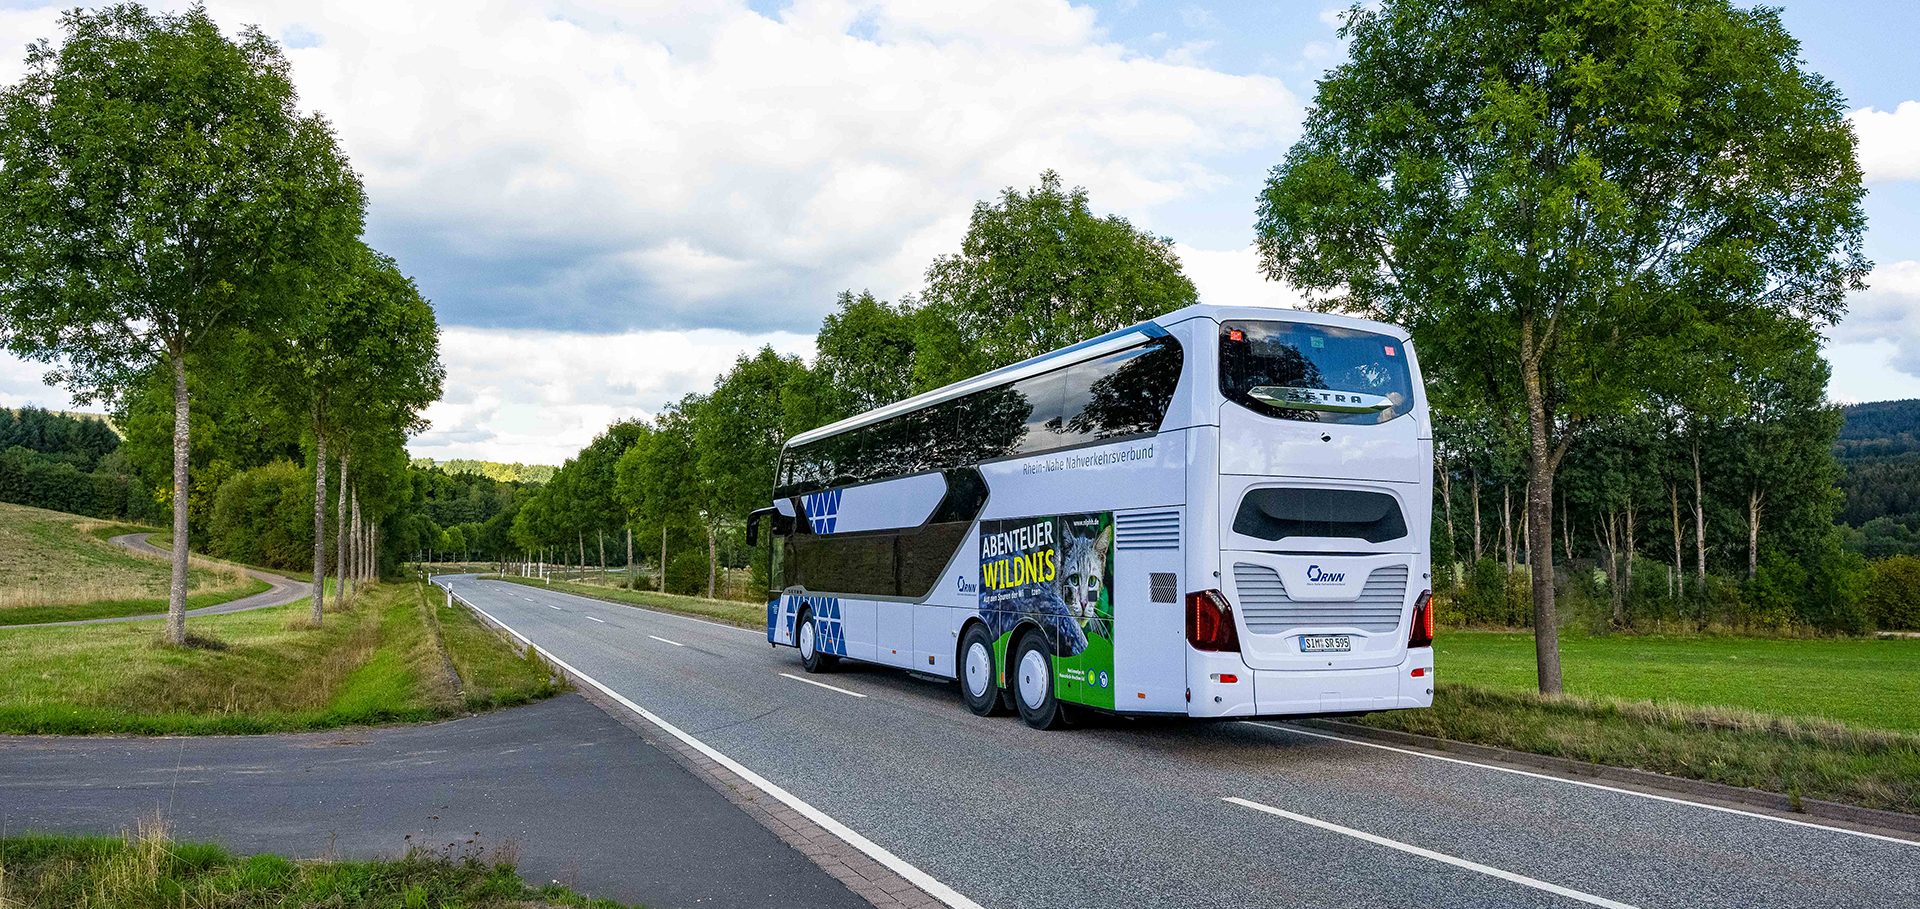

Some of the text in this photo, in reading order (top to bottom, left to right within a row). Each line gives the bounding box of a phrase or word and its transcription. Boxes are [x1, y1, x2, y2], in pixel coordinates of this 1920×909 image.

[1287, 389, 1362, 403] SETRA
[1022, 444, 1154, 475] Rhein-Nahe Nahverkehrsverbund
[982, 521, 1054, 559] ABENTEUER
[982, 548, 1056, 591] WILDNIS
[1320, 573, 1345, 582] RNN
[1306, 637, 1349, 648] SIM SR 595
